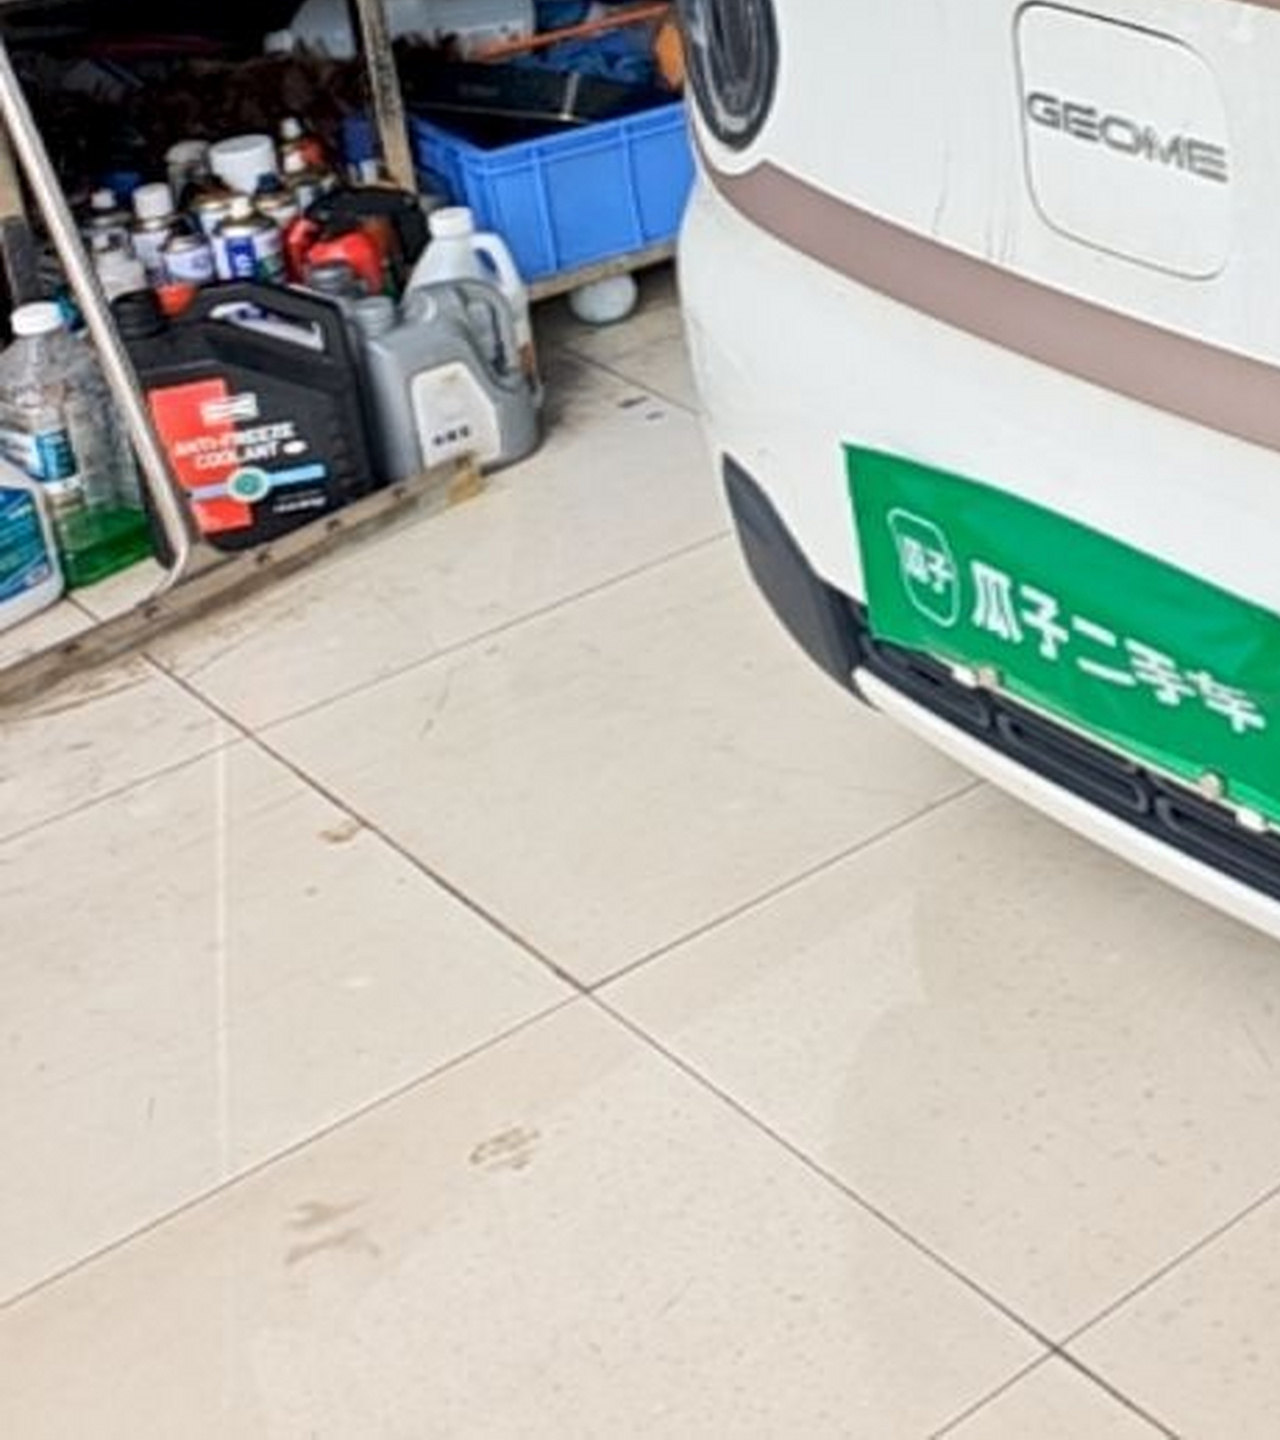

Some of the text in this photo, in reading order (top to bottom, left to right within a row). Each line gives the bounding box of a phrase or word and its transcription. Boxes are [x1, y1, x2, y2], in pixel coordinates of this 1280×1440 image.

[1026, 91, 1229, 183] GEOME
[195, 442, 280, 470] COOLANT
[969, 560, 1266, 734] 瓜子二手车
